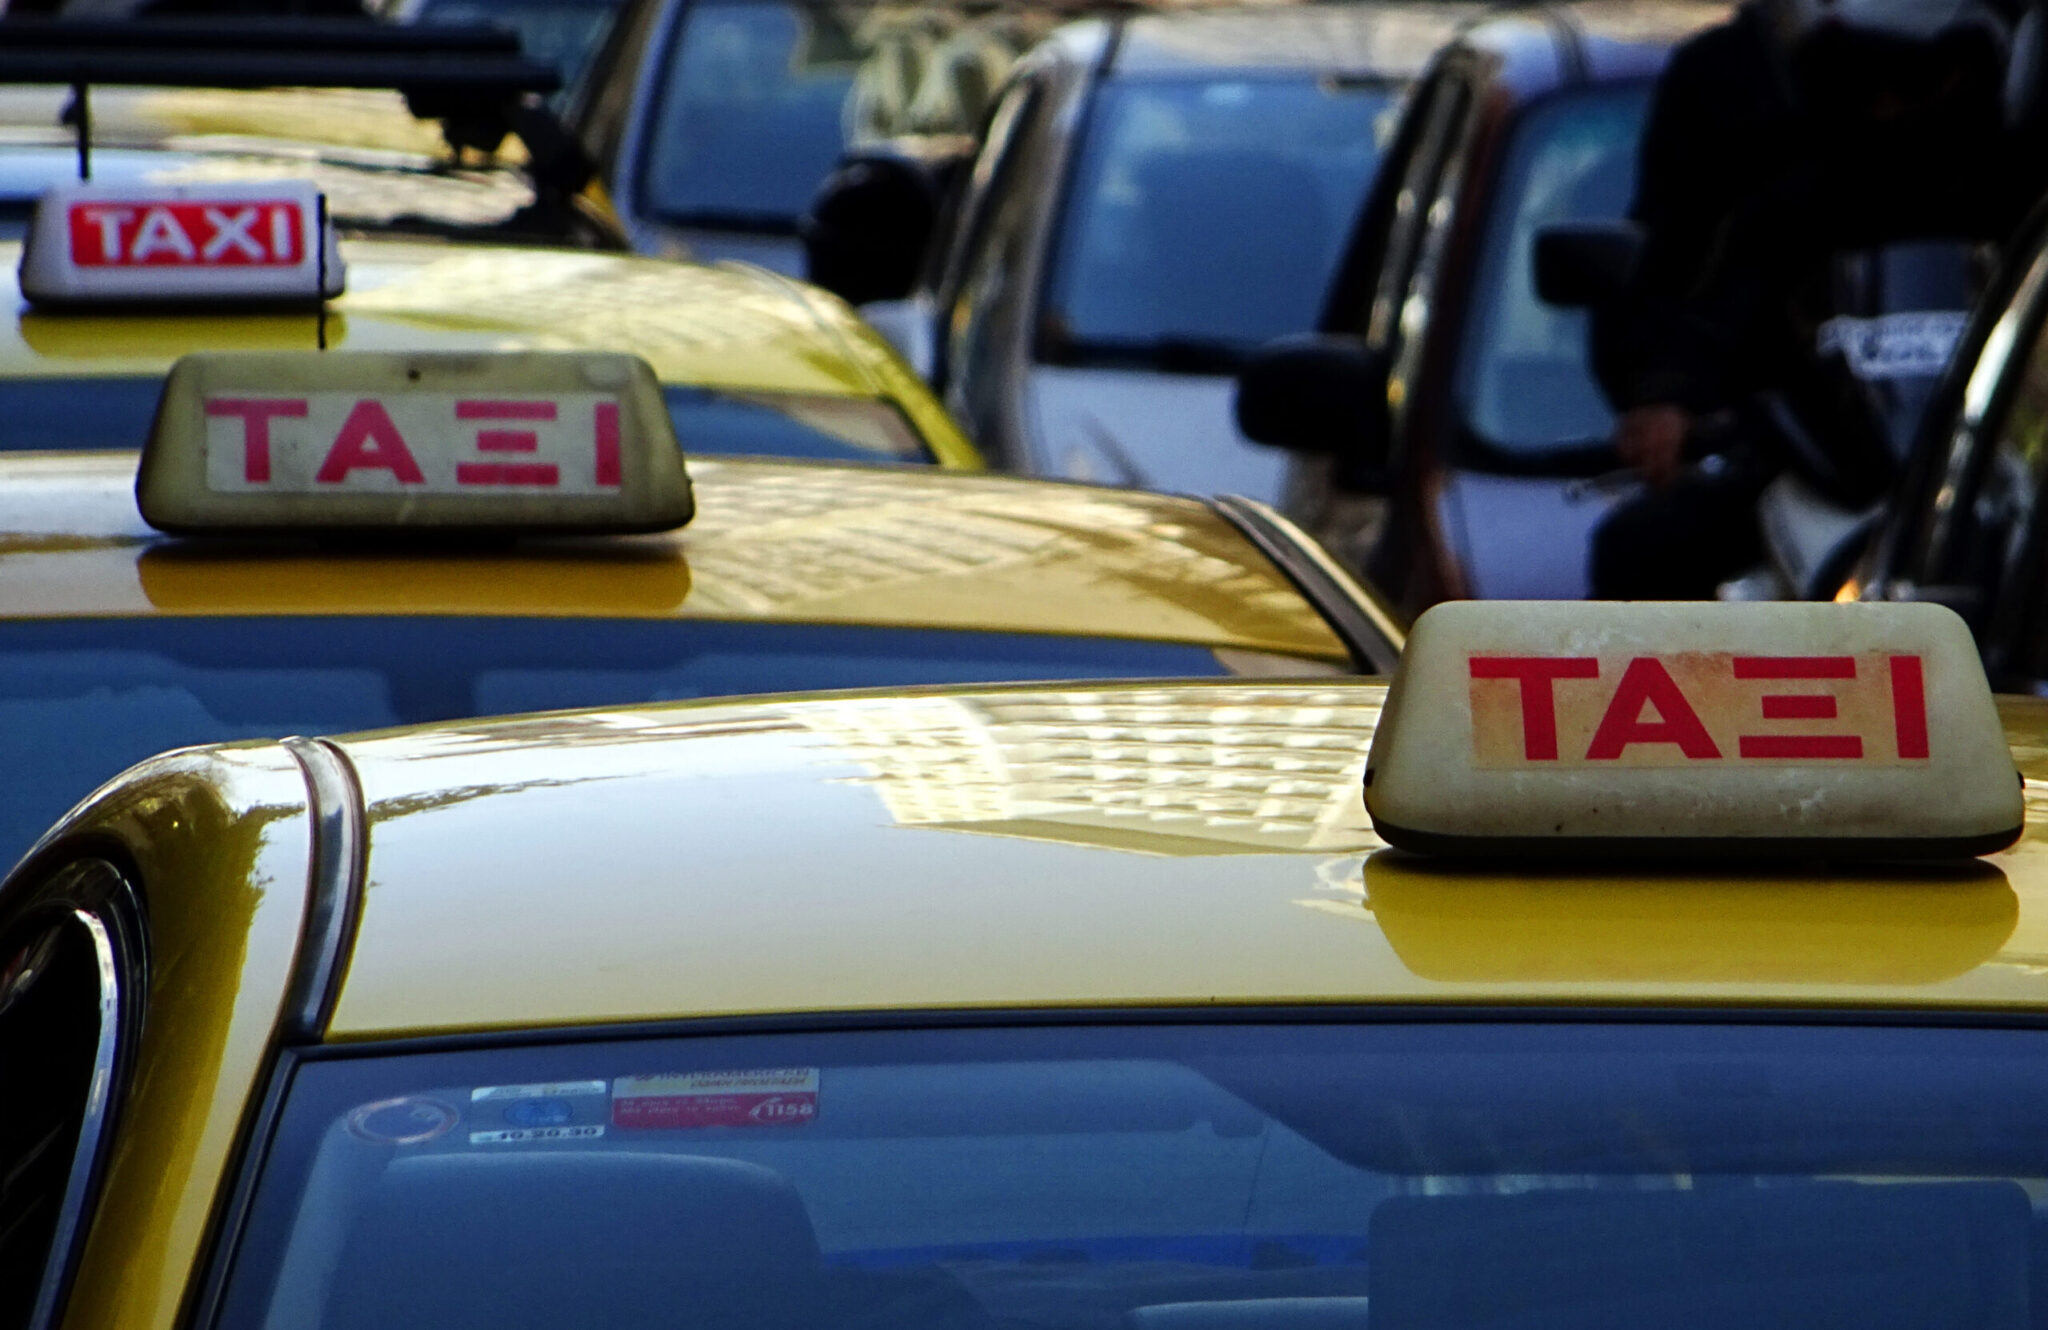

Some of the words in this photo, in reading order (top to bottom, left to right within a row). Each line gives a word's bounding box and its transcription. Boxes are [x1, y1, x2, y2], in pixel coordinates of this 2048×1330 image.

[84, 206, 294, 261] TAXI
[206, 399, 622, 487] ΤΑΞΙ
[1468, 655, 1930, 760] ΤΑΞΙ
[767, 1103, 814, 1117] 1158
